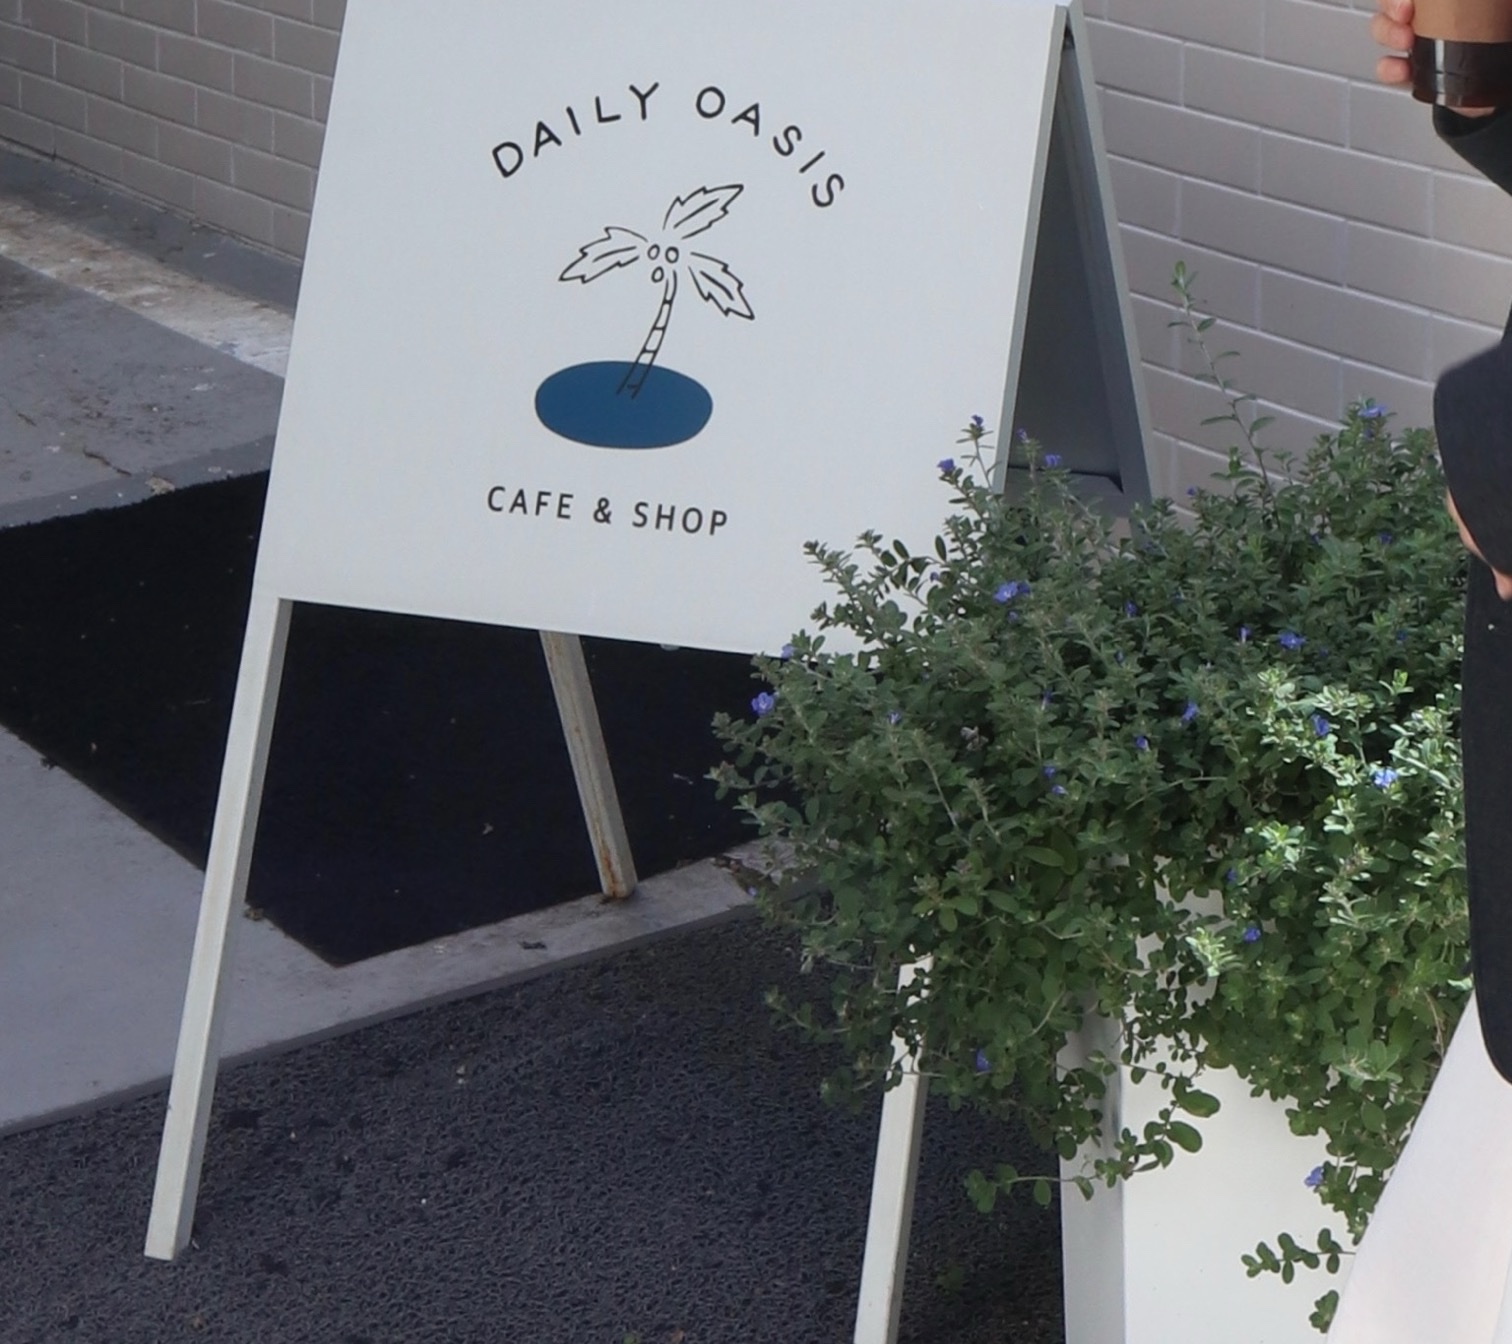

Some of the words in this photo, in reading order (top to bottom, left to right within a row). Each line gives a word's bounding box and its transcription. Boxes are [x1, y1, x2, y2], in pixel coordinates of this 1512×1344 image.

[491, 81, 660, 178] DAILY
[695, 86, 845, 208] OASIS
[486, 485, 575, 520] CAFE
[592, 497, 614, 524] &
[631, 501, 728, 536] SHOP
